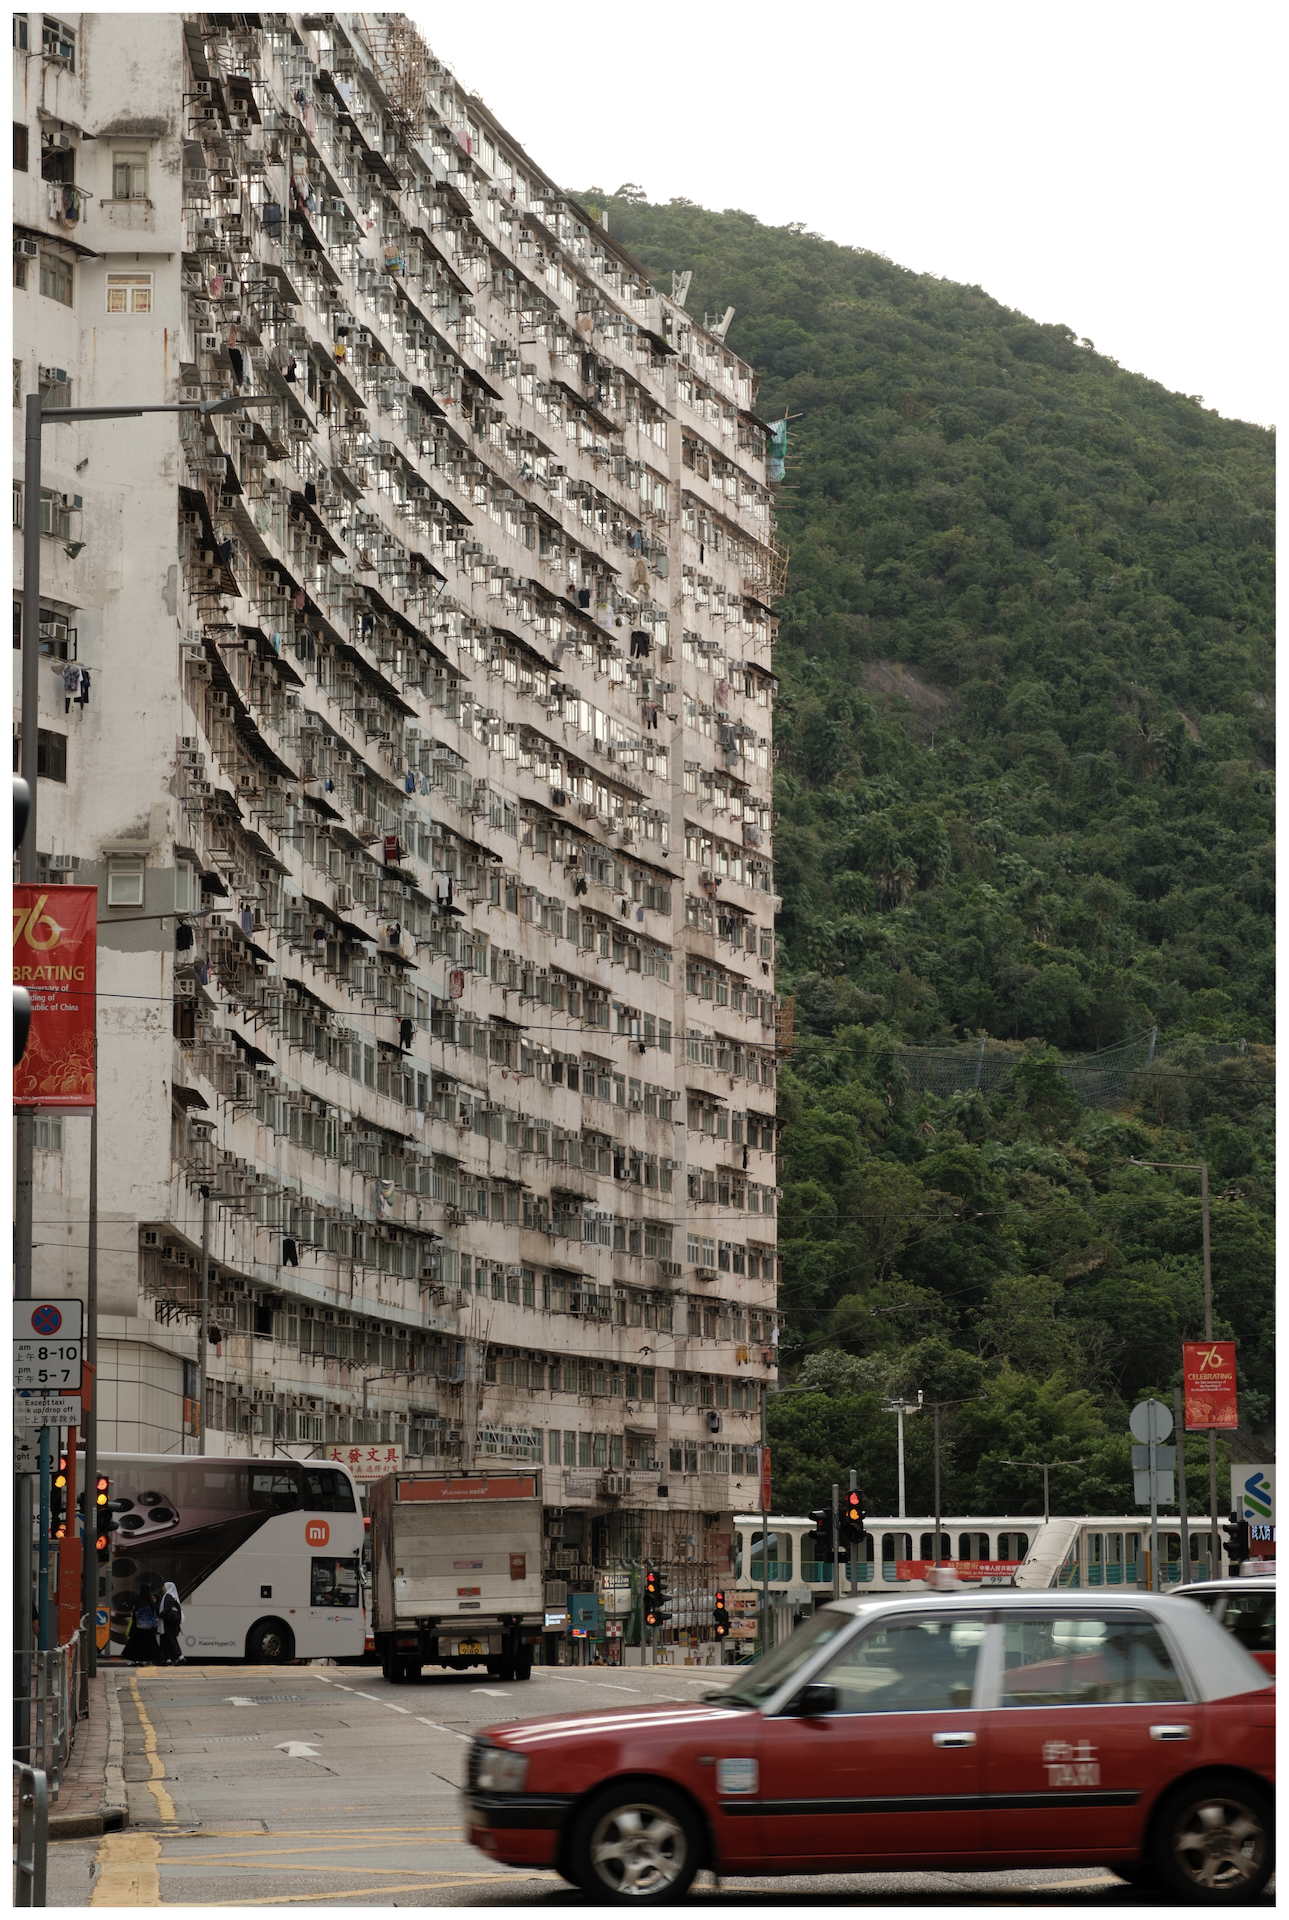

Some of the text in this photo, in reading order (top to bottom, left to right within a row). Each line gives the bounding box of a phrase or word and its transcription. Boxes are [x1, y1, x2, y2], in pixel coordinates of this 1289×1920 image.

[13, 894, 61, 950] 76
[22, 984, 69, 993] nniversary of
[15, 1347, 77, 1361] 上午 8-10
[1197, 1346, 1223, 1371] 76
[15, 1375, 35, 1384] 下午
[330, 1448, 400, 1463] 大發文具
